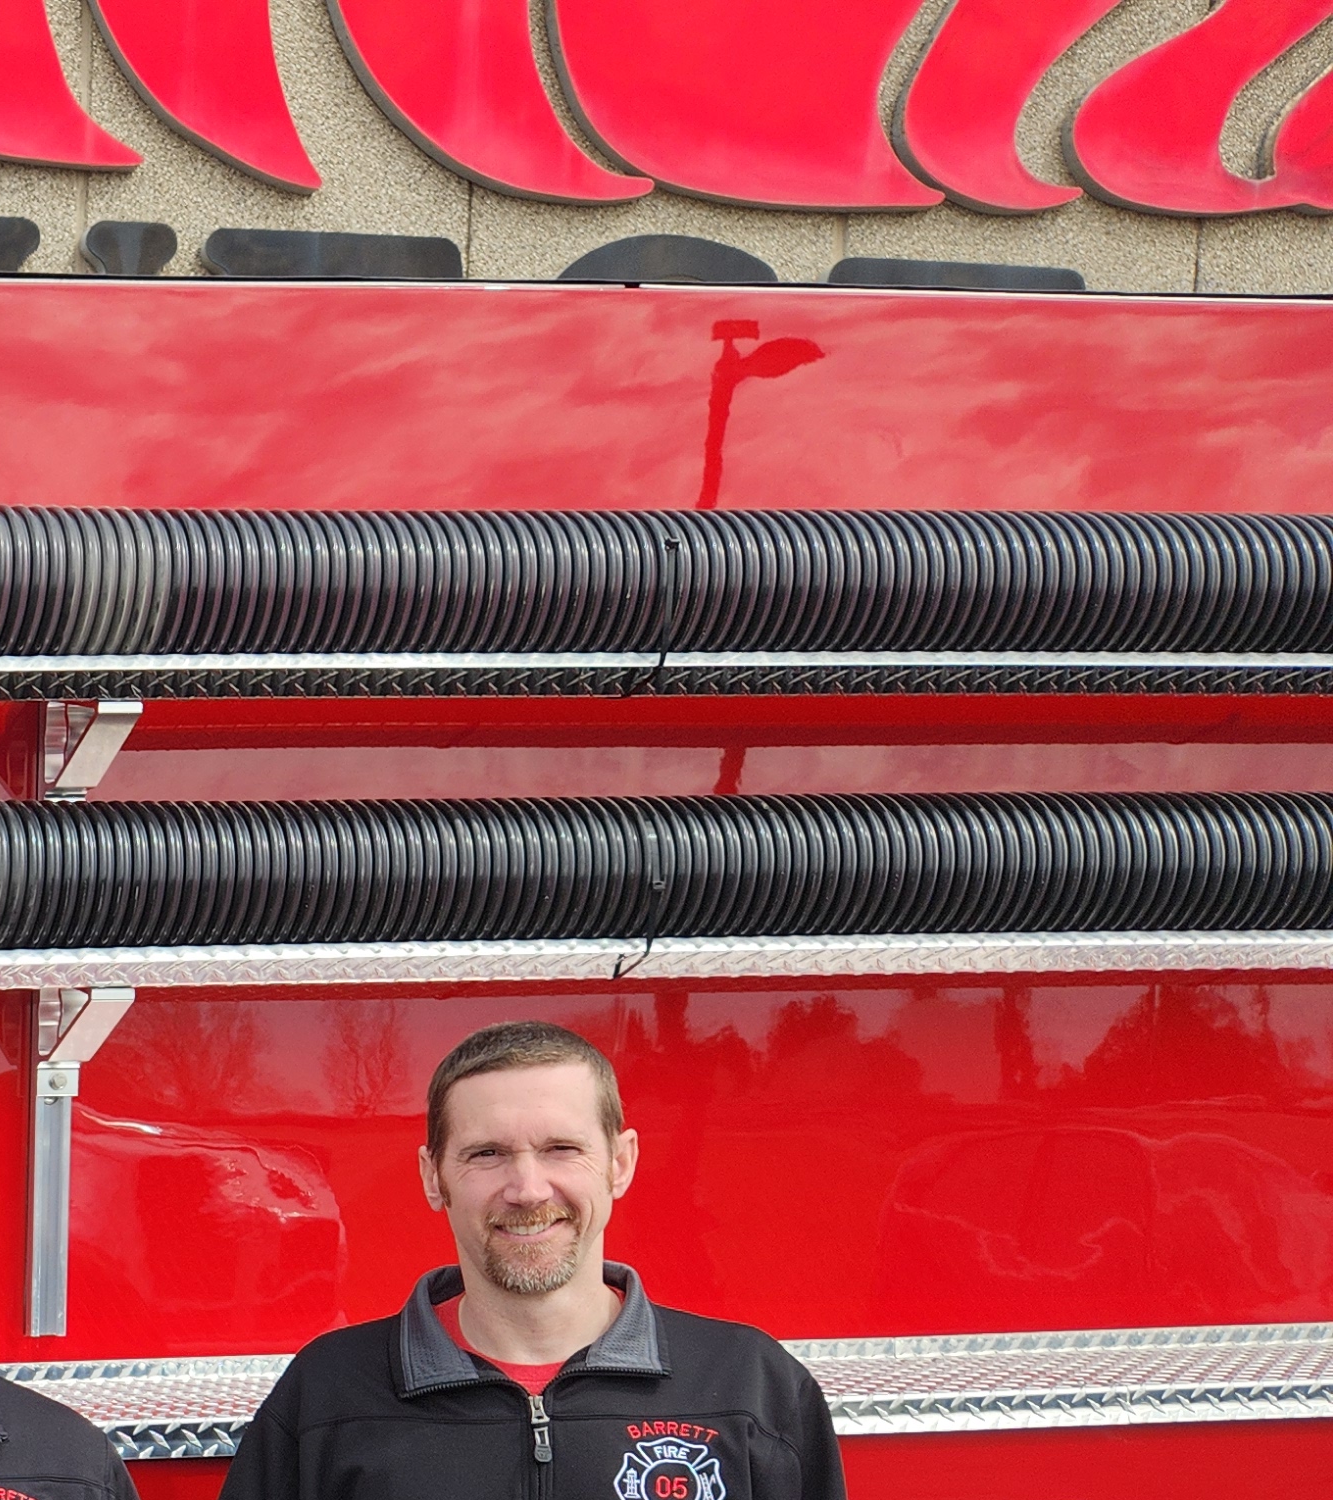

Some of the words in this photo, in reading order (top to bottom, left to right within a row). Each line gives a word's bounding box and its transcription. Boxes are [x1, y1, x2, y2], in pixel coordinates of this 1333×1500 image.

[626, 1420, 719, 1443] BARRETT
[653, 1444, 690, 1459] FIRE
[655, 1475, 688, 1499] 05
